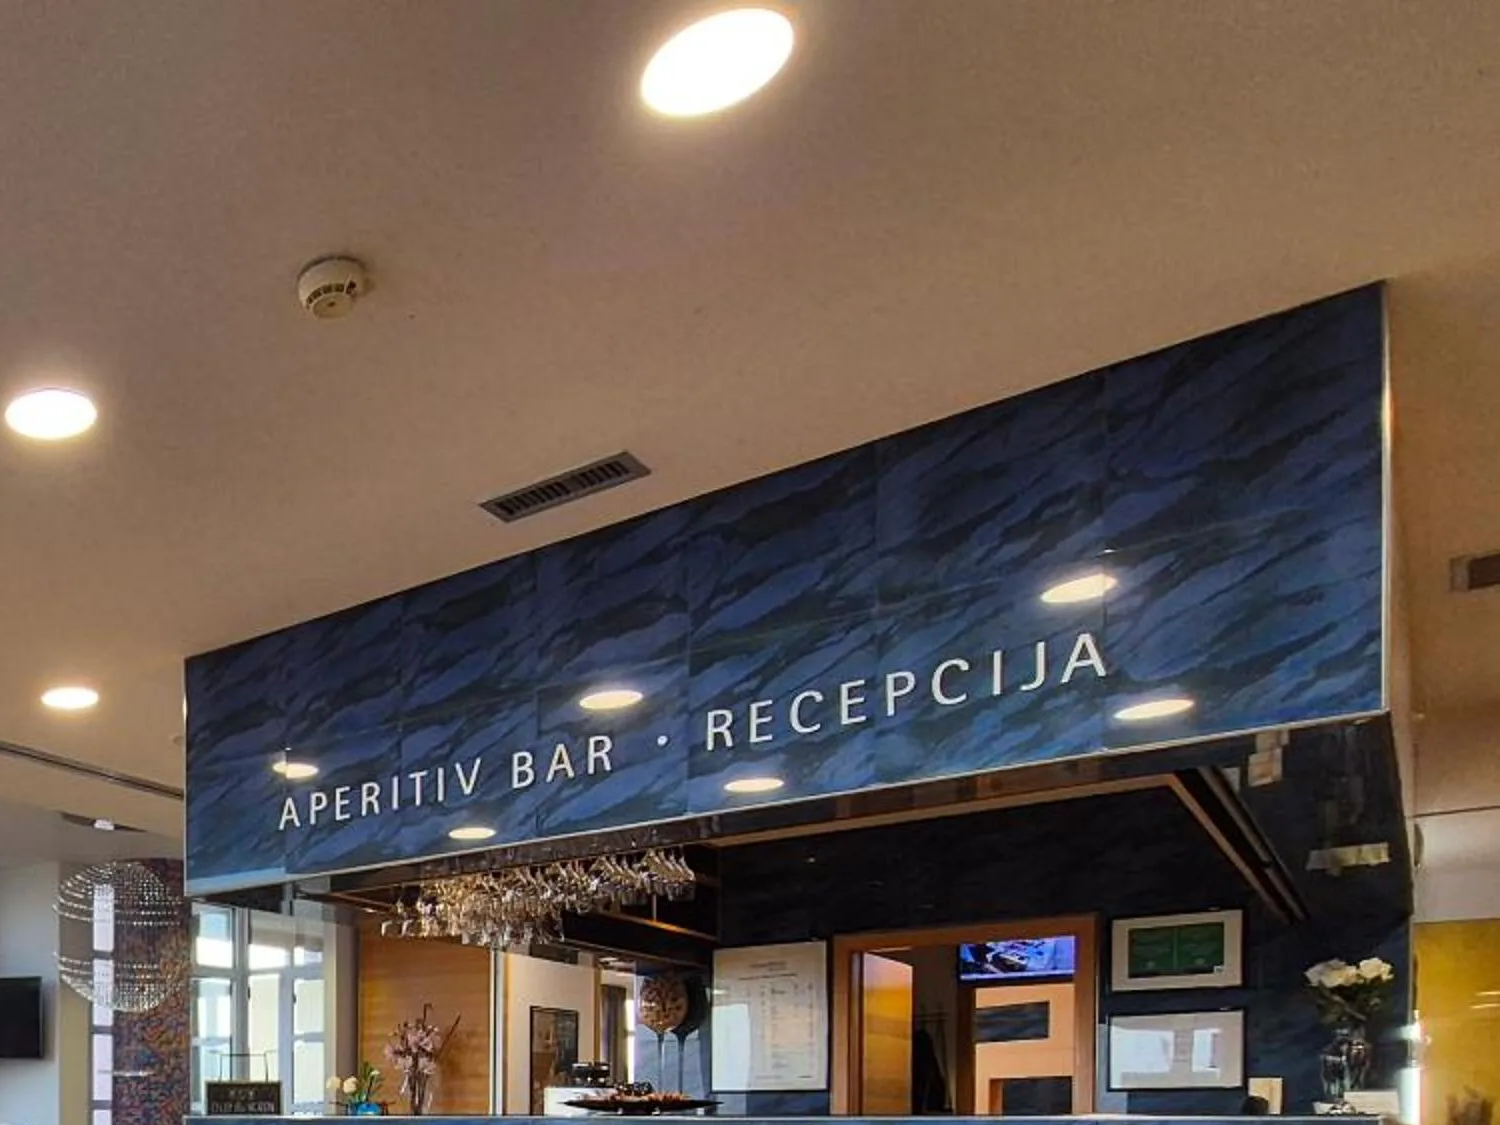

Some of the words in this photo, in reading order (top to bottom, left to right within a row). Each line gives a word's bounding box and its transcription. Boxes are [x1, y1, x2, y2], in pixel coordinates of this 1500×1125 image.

[279, 757, 481, 830] APERITIV
[511, 735, 613, 789] BAR
[706, 632, 1107, 751] RECEPCIJA
